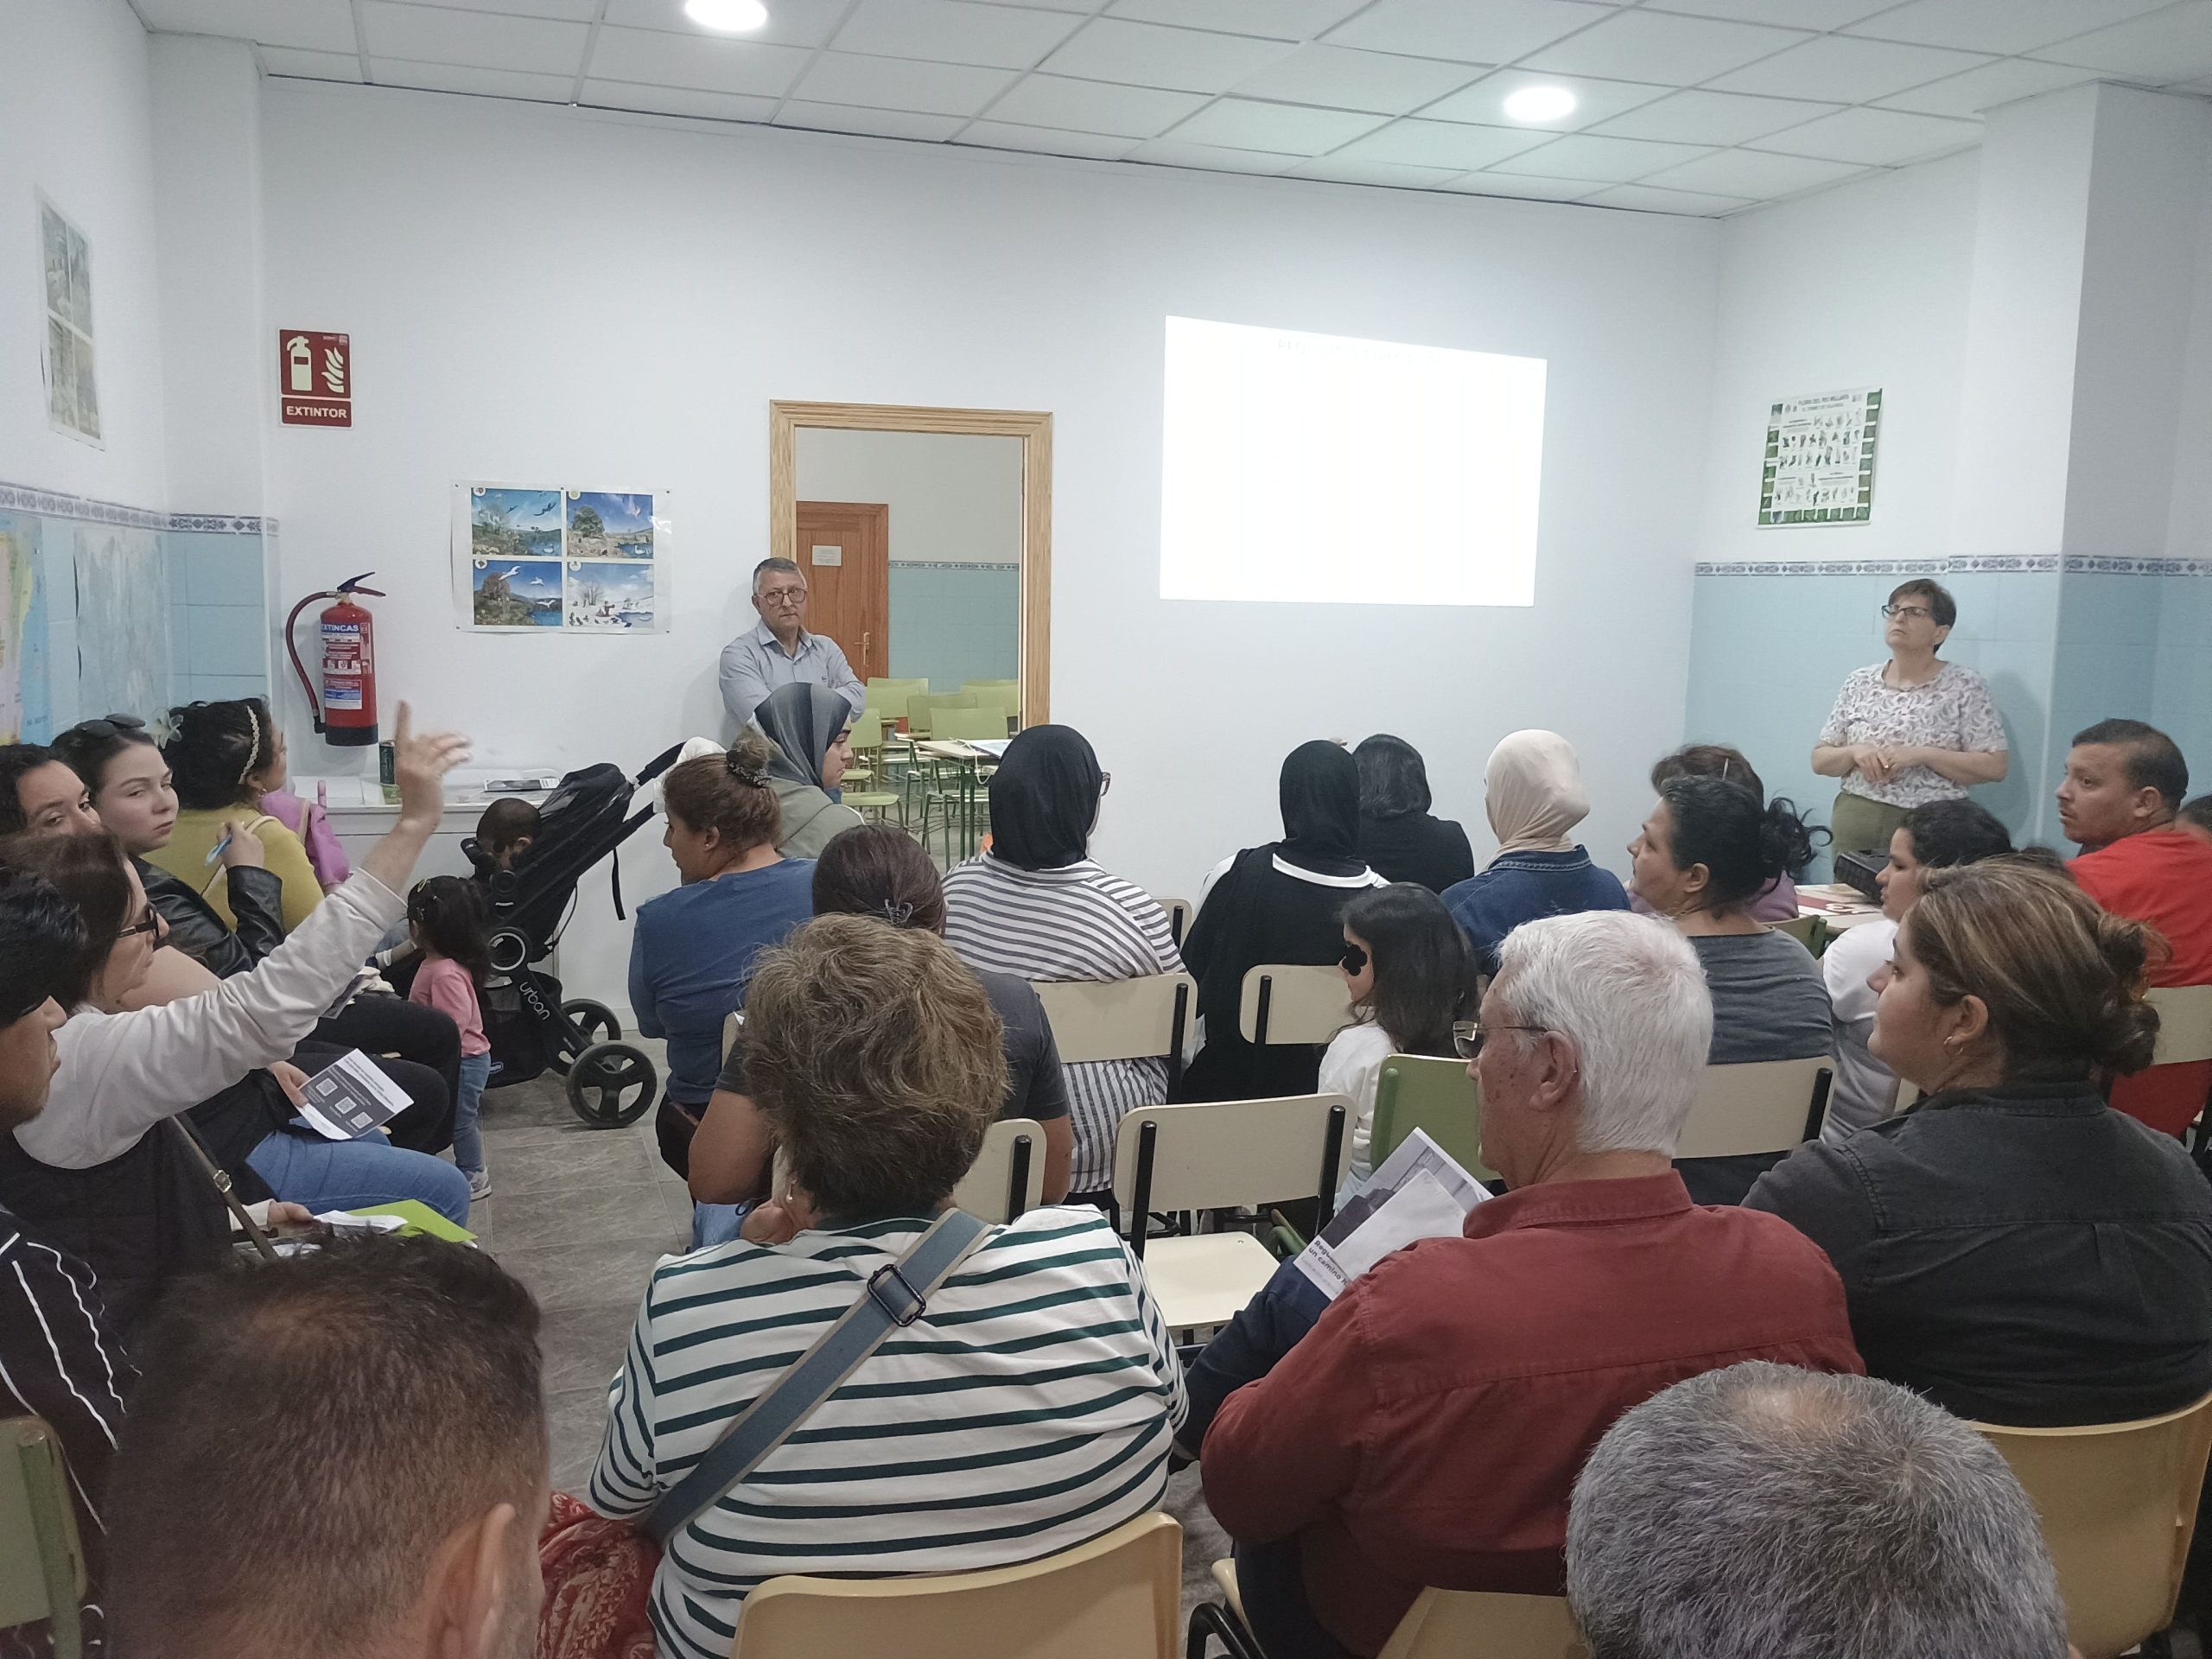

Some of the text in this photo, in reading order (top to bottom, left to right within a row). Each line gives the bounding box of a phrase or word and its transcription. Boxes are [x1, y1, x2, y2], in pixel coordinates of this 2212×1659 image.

[286, 405, 347, 418] EXTINTOR
[519, 982, 550, 1020] urban
[1308, 1247, 1318, 1257] un
[1318, 1256, 1341, 1280] camino
